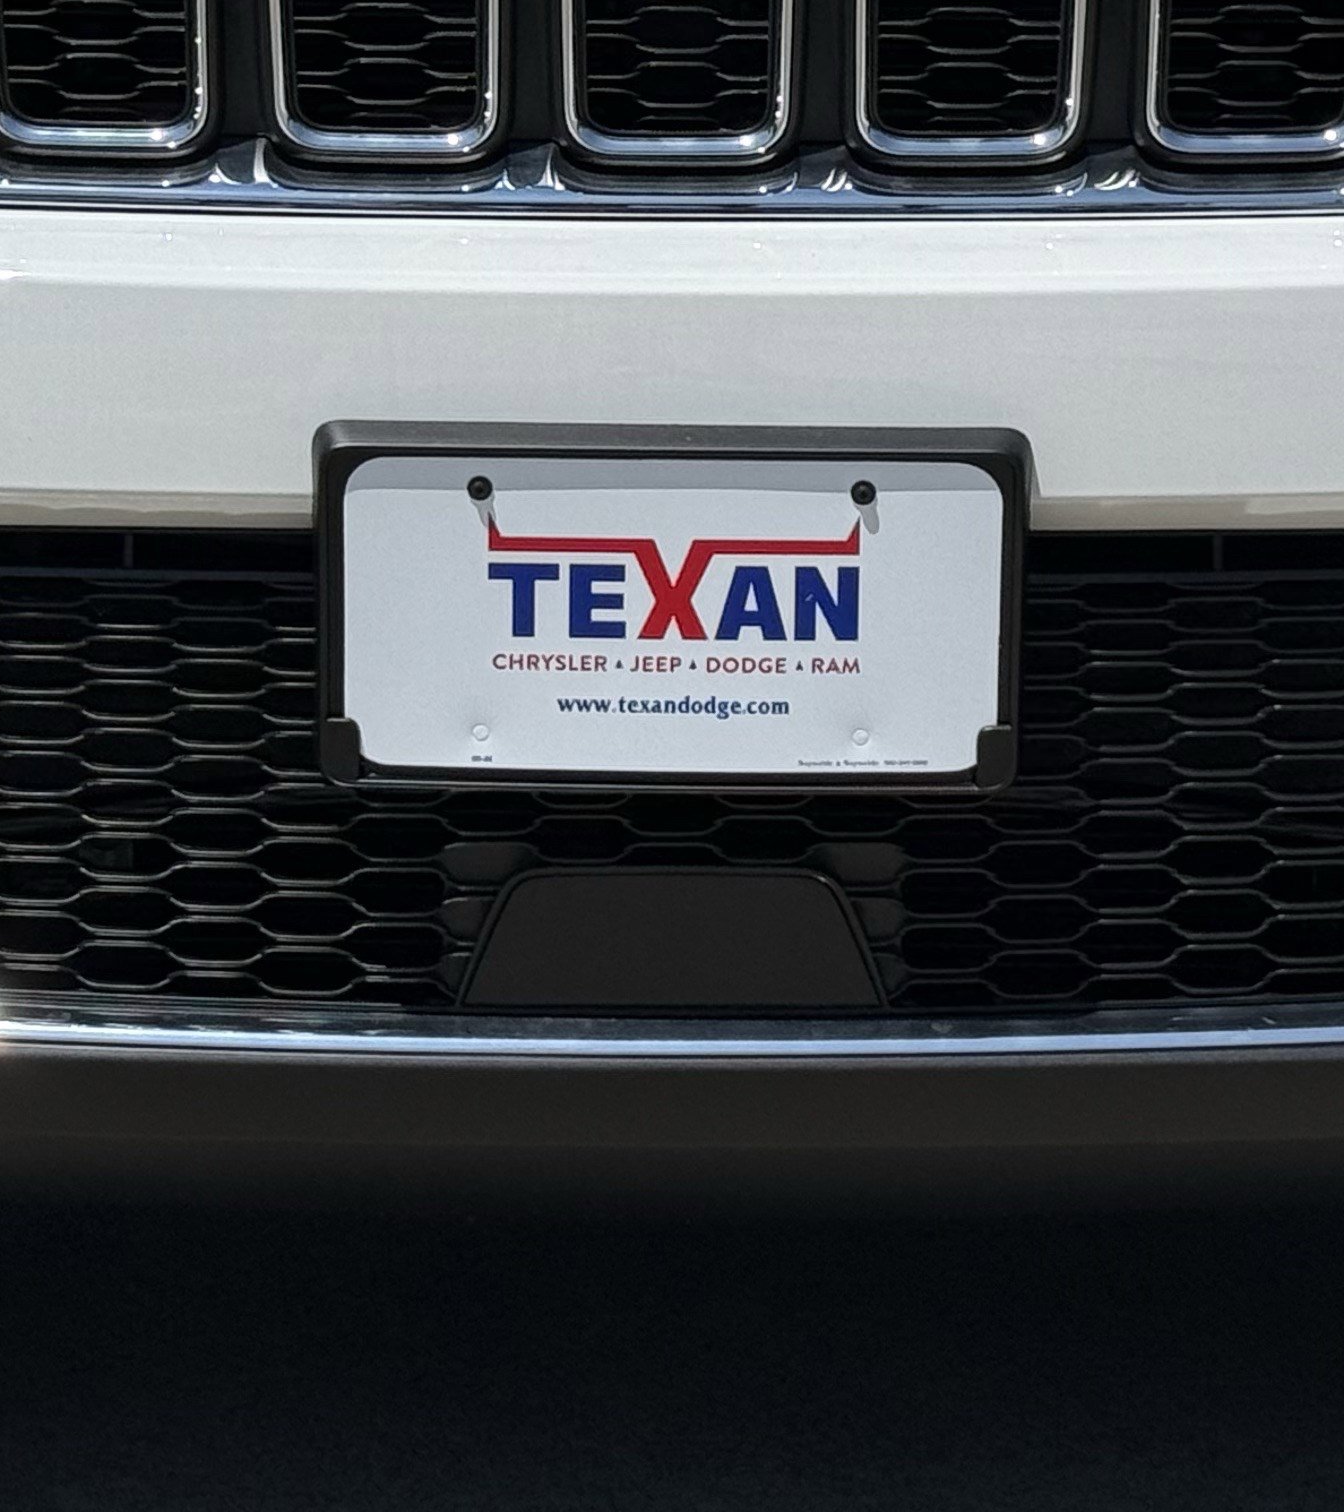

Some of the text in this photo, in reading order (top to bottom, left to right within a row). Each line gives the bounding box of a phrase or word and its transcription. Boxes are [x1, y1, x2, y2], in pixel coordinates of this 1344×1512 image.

[488, 534, 861, 642] TEXAN
[491, 653, 861, 675] CHRYSLER JEEP DODGE RAM
[556, 695, 790, 720] www.texandodge.com
